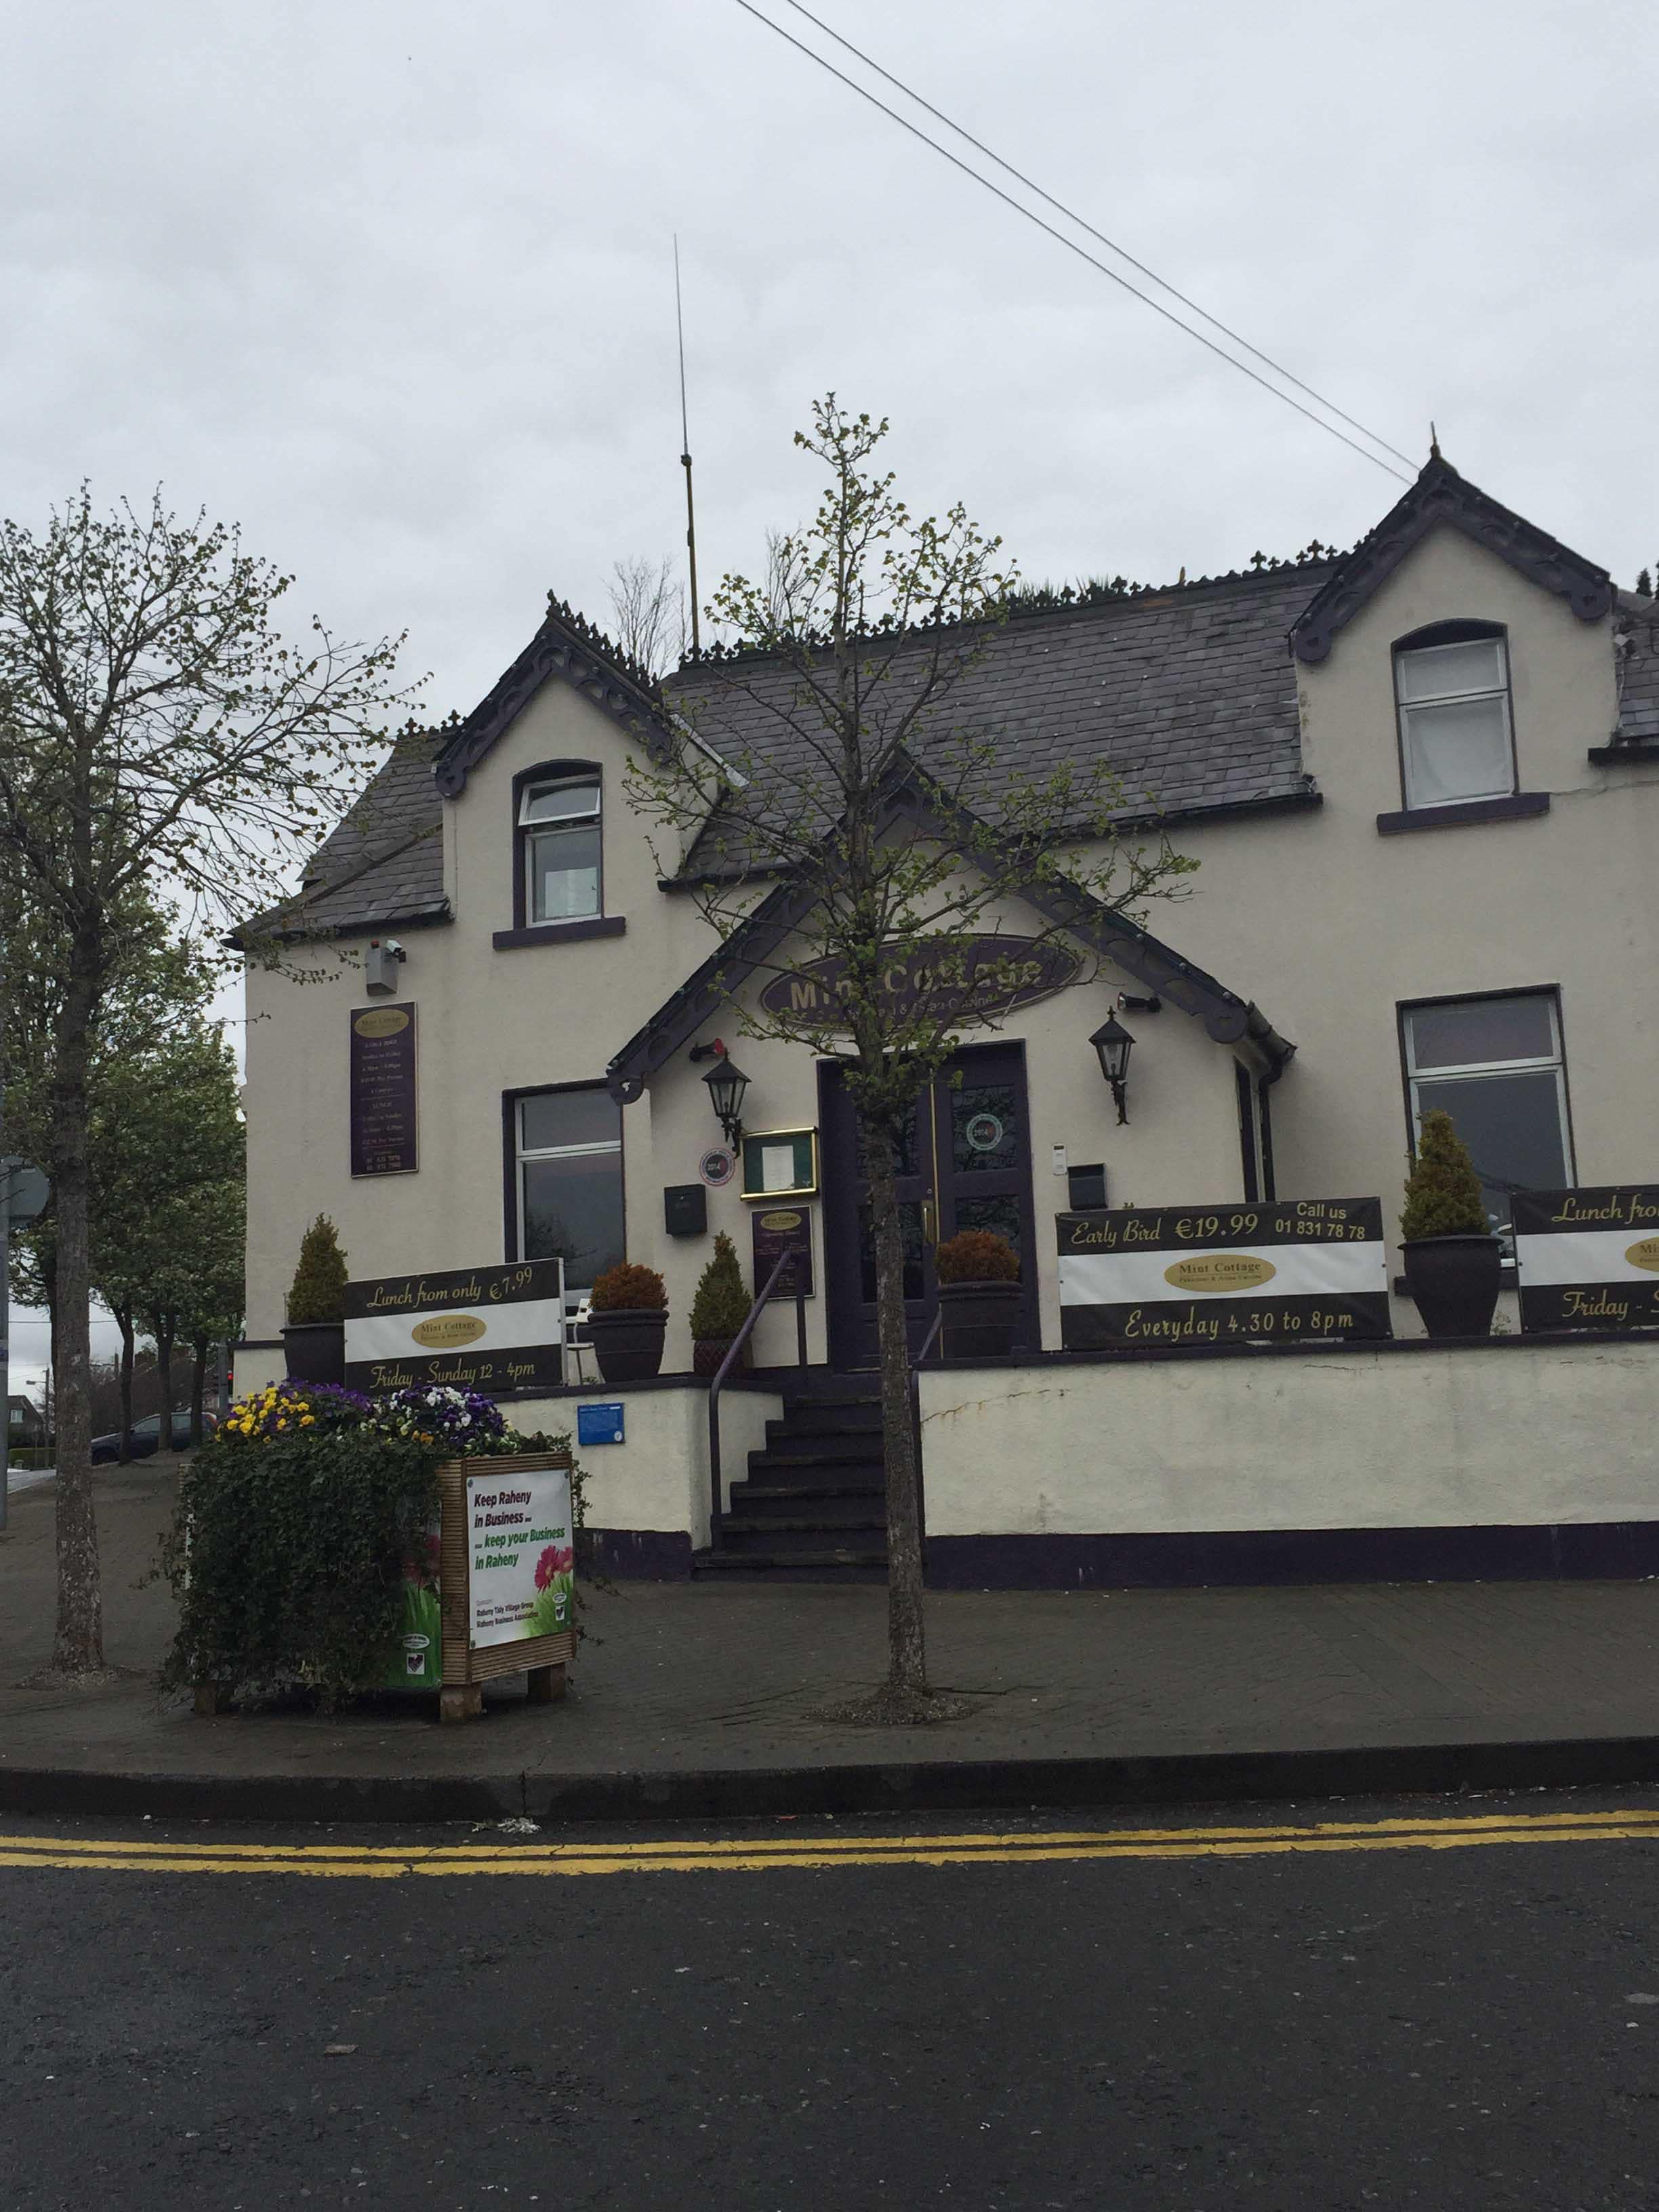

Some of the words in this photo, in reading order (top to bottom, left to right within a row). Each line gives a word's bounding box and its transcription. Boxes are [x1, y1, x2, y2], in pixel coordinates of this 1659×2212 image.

[1296, 1202, 1324, 1217] Call
[1329, 1207, 1347, 1219] us
[1551, 1195, 1623, 1222] Lunch
[1624, 1193, 1659, 1225] fro
[1071, 1222, 1117, 1248] Early
[1122, 1218, 1162, 1242] Bird
[1174, 1214, 1258, 1239] €19.99
[1275, 1218, 1291, 1233] 01
[1296, 1221, 1322, 1236] 831
[1327, 1223, 1344, 1238] 78
[1348, 1225, 1366, 1240] 78
[1180, 1265, 1208, 1273] Mint
[1214, 1263, 1261, 1273] Cottage
[367, 1281, 412, 1307] Lunch
[413, 1281, 447, 1307] from
[453, 1276, 481, 1300] only
[1561, 1289, 1629, 1321] Friday
[1125, 1305, 1219, 1342] Everyday
[1228, 1313, 1274, 1332] 4.30
[1283, 1311, 1300, 1330] to
[1311, 1310, 1353, 1336] 8pm
[370, 1365, 413, 1389] Friday
[428, 1358, 475, 1385] Sunday
[480, 1364, 493, 1379] 12
[507, 1362, 535, 1381] 4pm
[474, 1493, 497, 1509] Keep
[498, 1490, 532, 1504] Raheny
[474, 1514, 483, 1528] in
[485, 1511, 524, 1527] Business
[485, 1534, 506, 1549] keep
[508, 1532, 529, 1547] your
[529, 1527, 565, 1542] Business
[475, 1556, 484, 1570] in
[485, 1553, 519, 1568] Raheny
